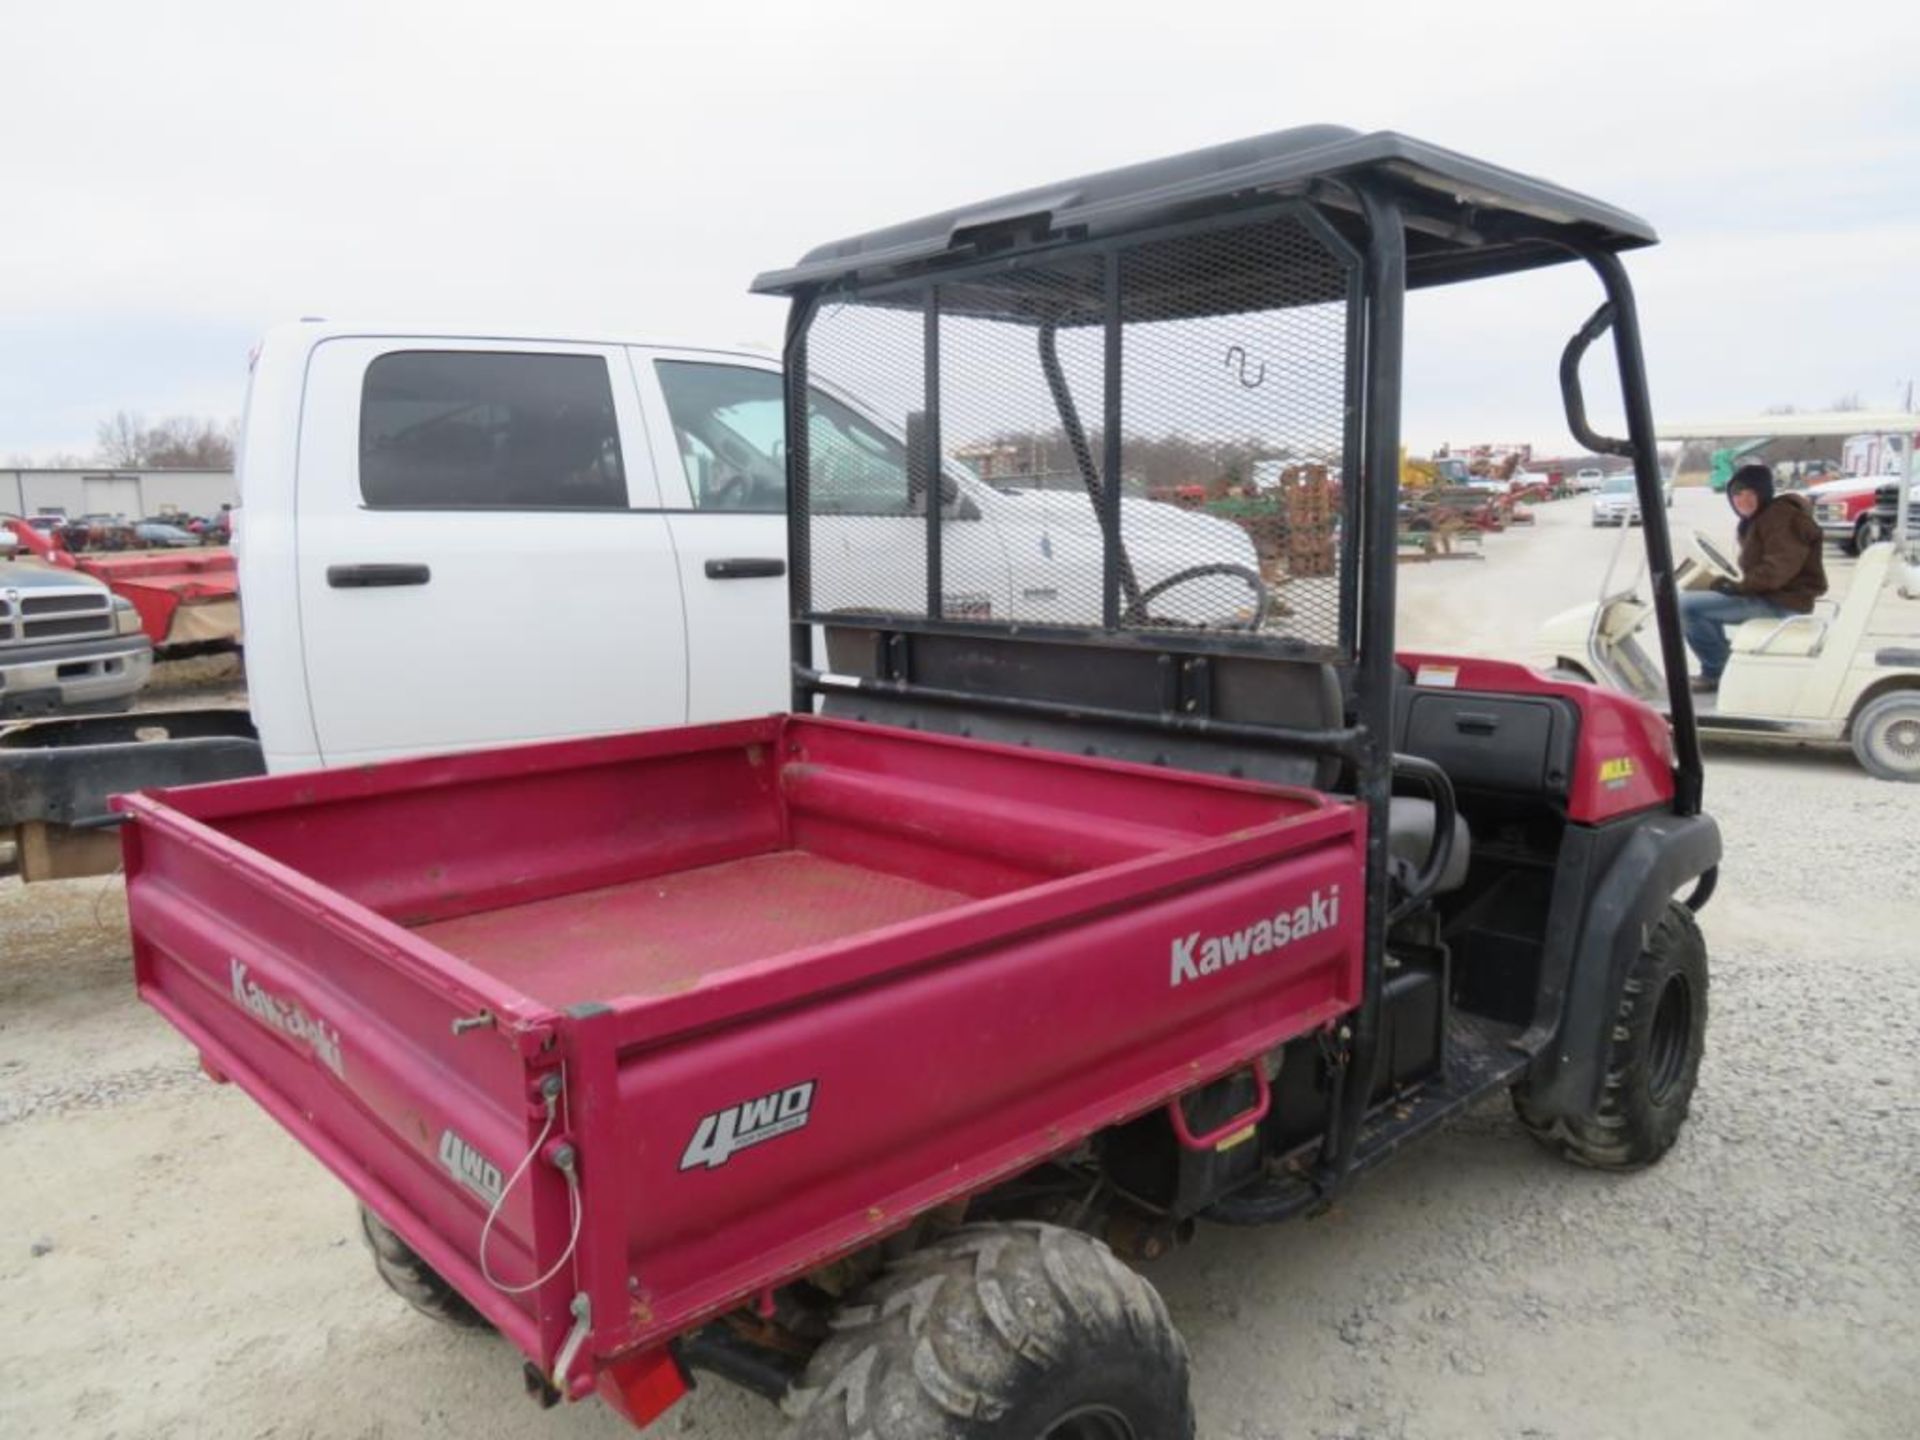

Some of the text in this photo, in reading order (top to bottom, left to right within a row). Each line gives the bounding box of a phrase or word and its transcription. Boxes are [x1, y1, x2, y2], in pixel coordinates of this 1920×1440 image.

[1170, 884, 1339, 987] Kawasaki
[231, 958, 344, 1077] Kawasaki
[438, 1129, 502, 1198] 4WD
[679, 1081, 815, 1171] 4WD
